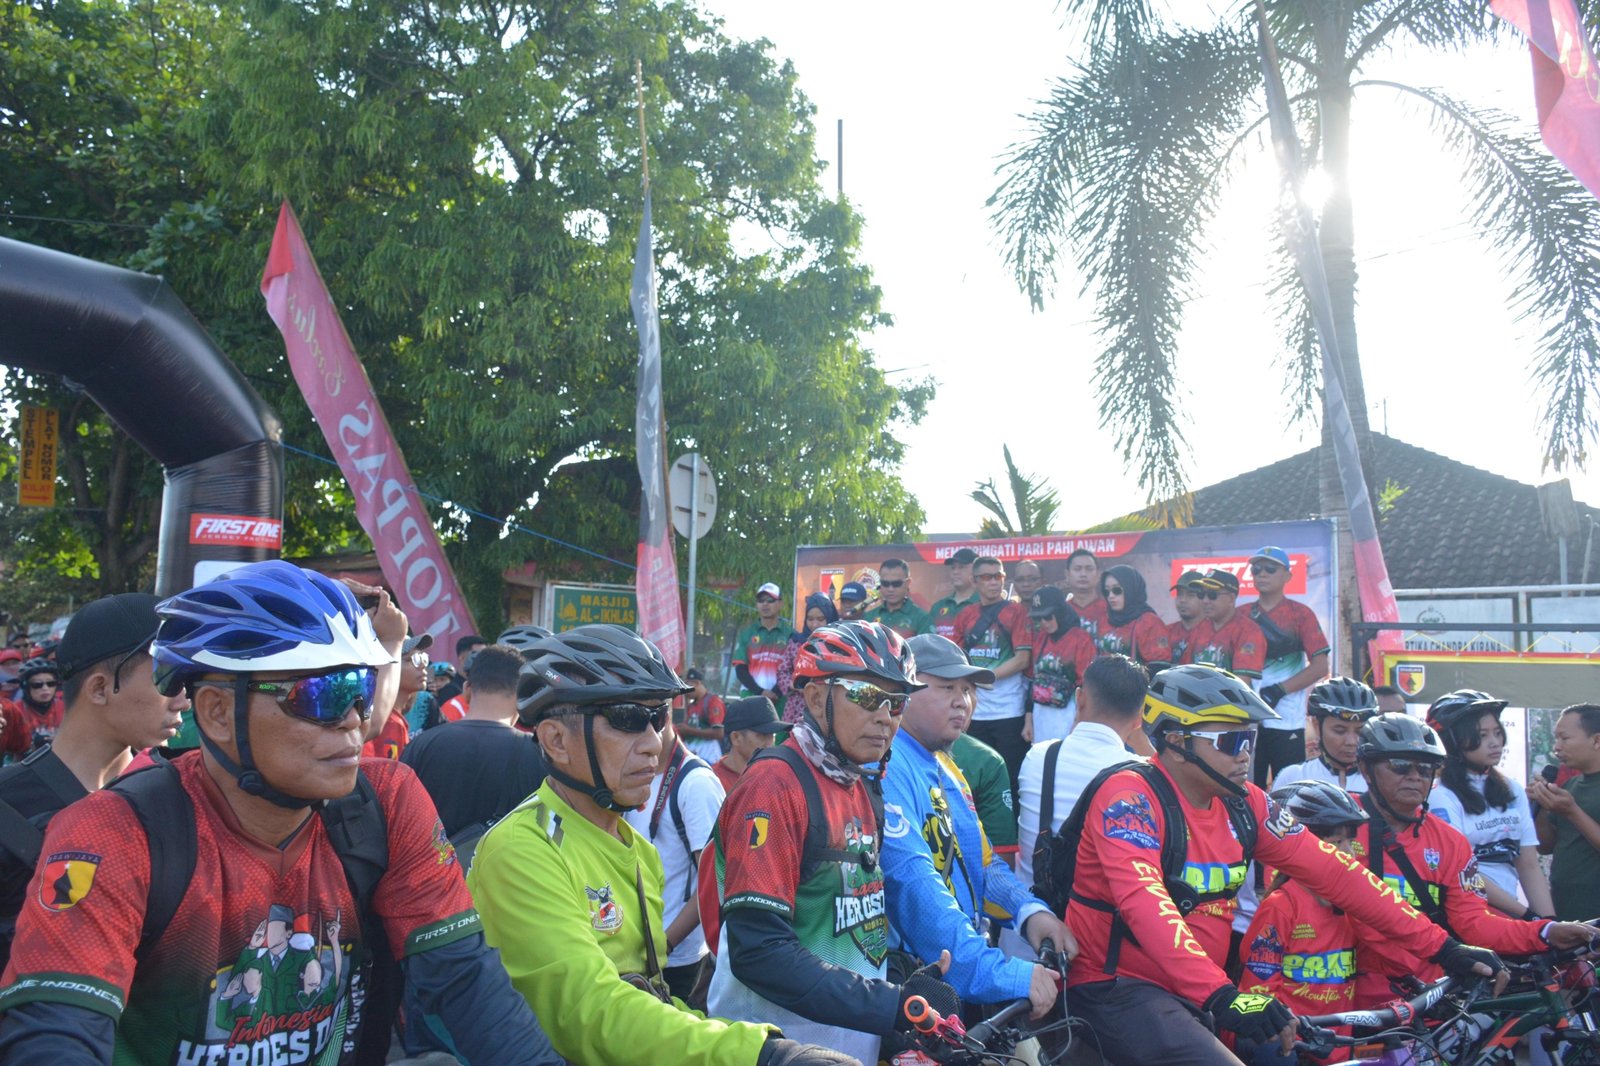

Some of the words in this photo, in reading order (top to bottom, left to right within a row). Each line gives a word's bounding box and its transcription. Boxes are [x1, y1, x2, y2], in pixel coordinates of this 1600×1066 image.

[44, 410, 55, 439] PLAT
[23, 408, 36, 479] STEMPEL
[41, 444, 53, 480] NOMOR
[1017, 542, 1044, 556] HARI
[580, 594, 630, 608] MASJID
[664, 766, 676, 785] EOS
[747, 896, 790, 912] INDONESIA
[415, 922, 457, 943] FIRST
[226, 1003, 334, 1049] Indonesia
